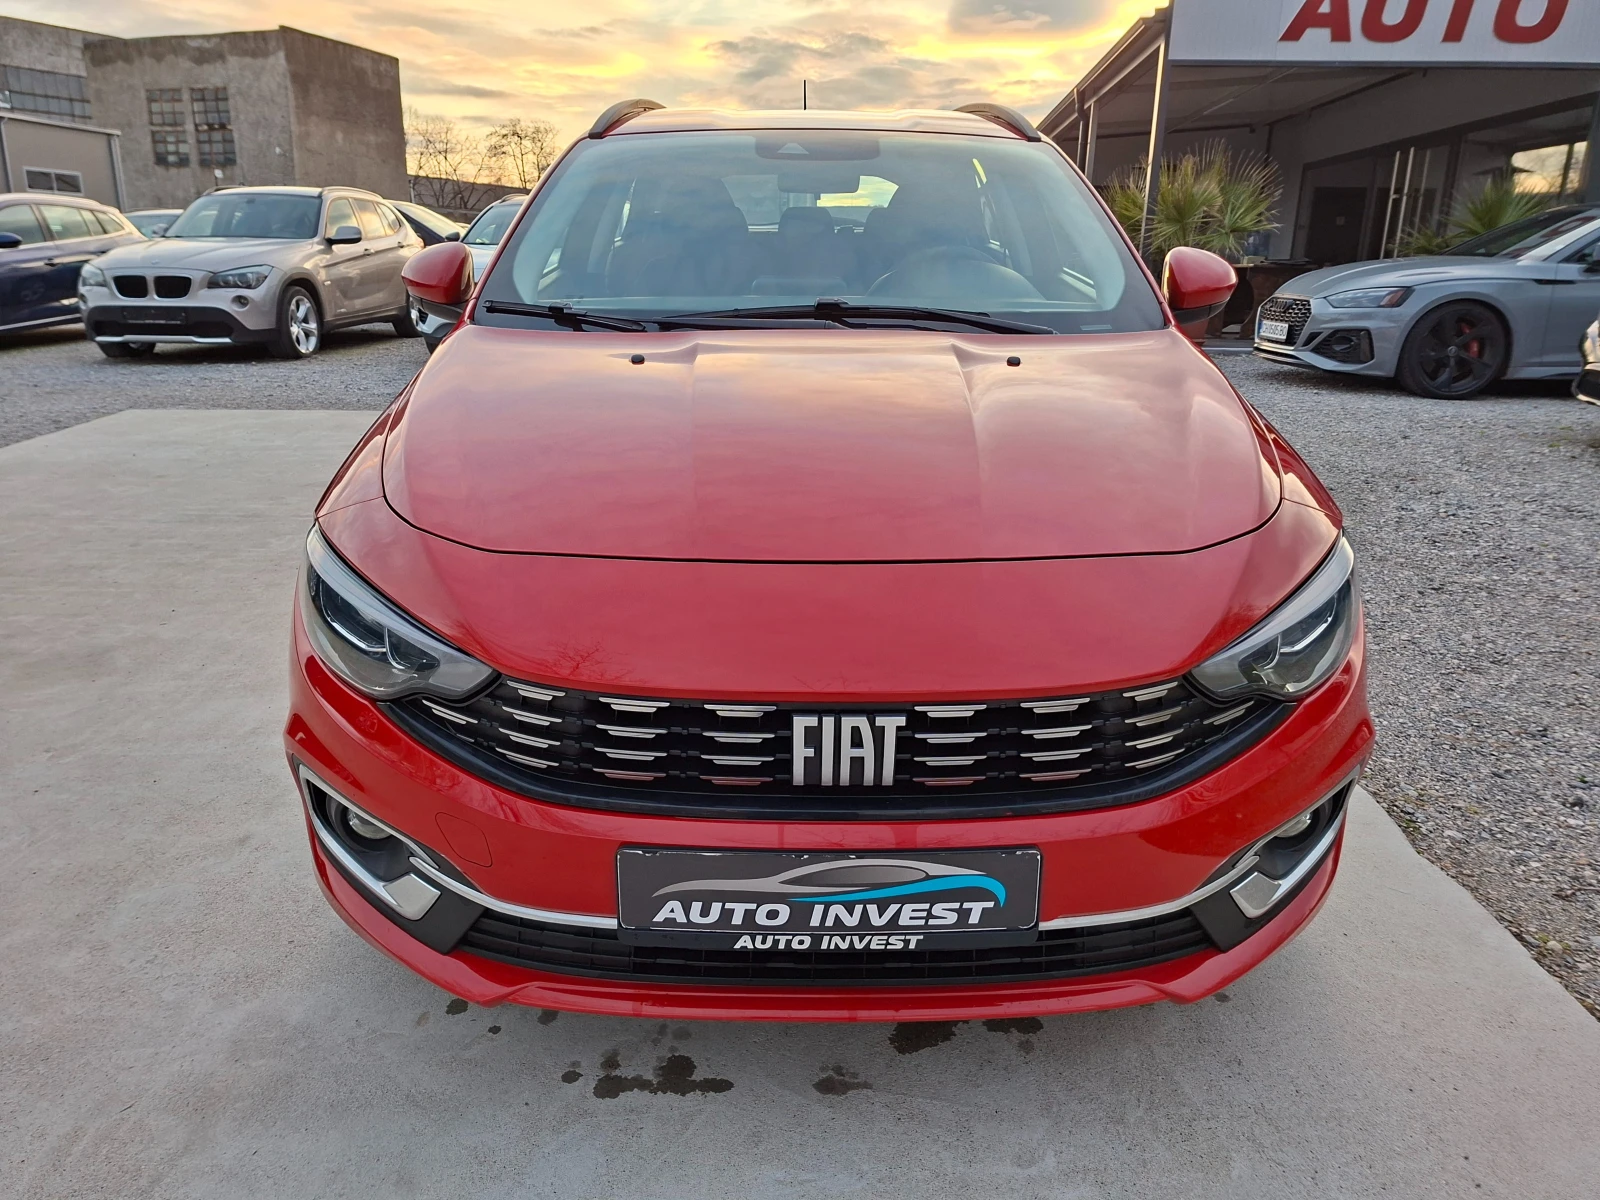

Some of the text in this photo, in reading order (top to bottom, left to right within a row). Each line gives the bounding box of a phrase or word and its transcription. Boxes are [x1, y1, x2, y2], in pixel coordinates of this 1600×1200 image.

[792, 714, 907, 786] FIAT
[652, 900, 995, 927] AUTO INVEST
[733, 934, 924, 950] AUTO INVEST
